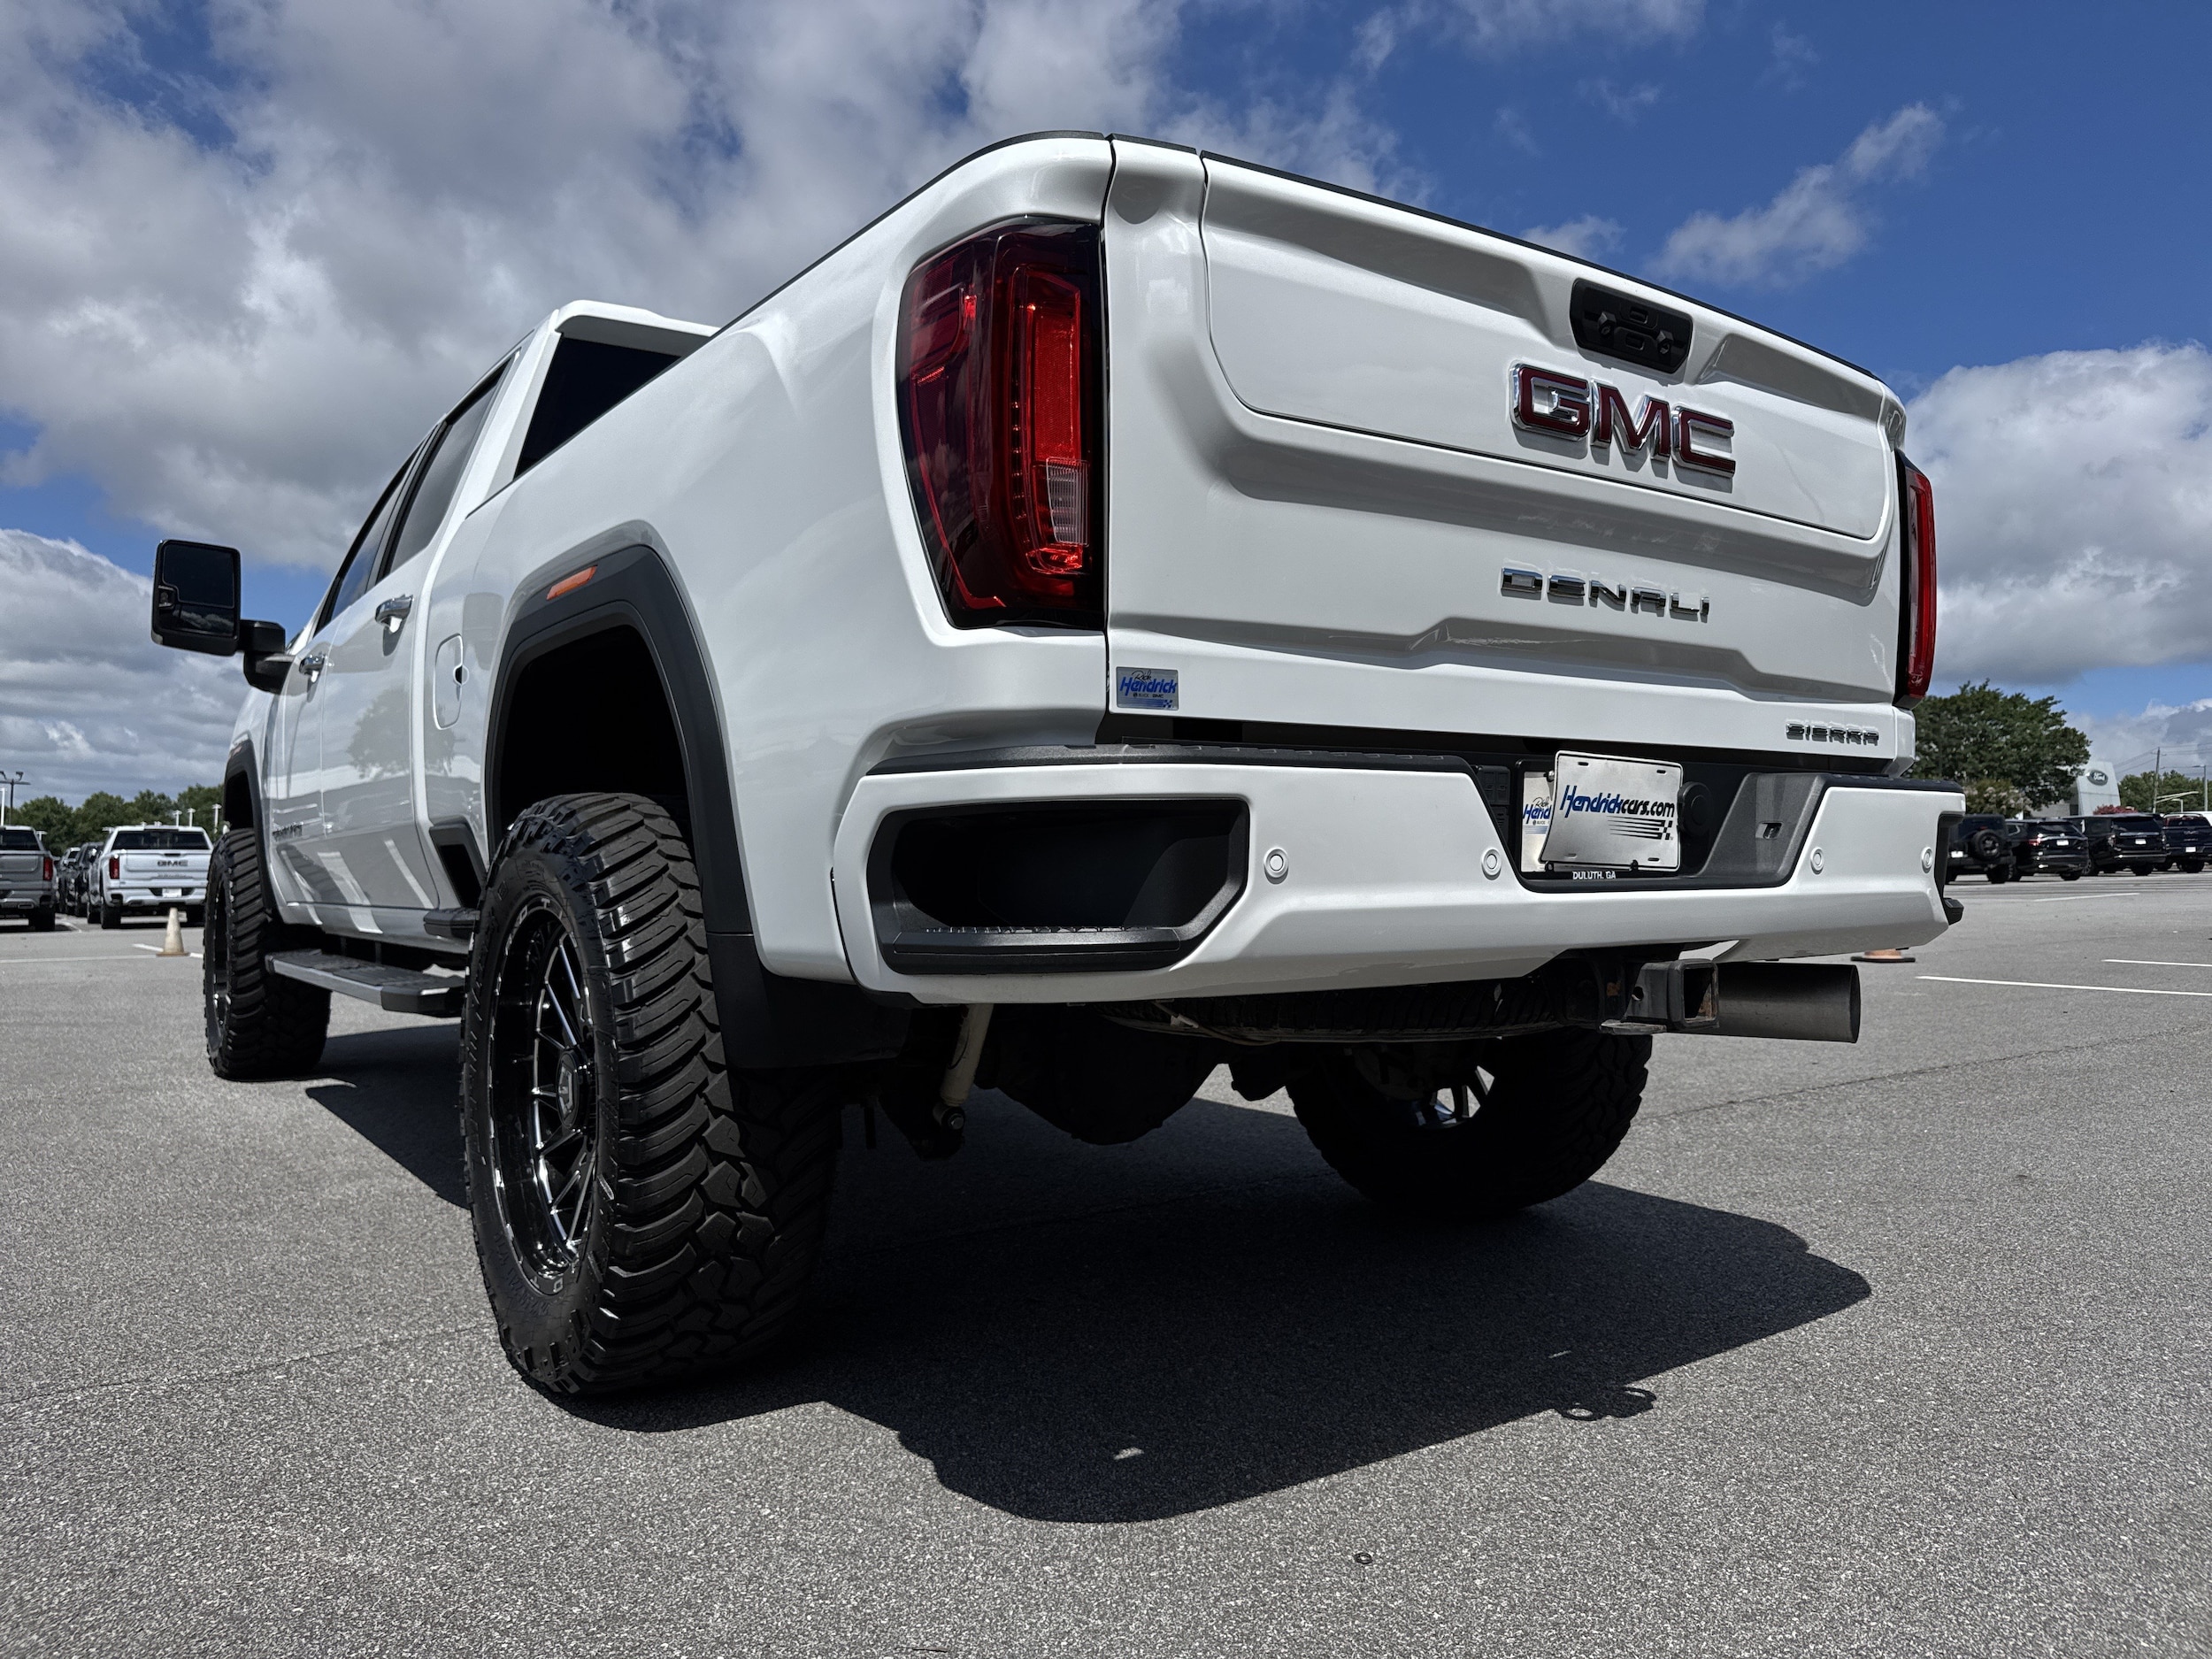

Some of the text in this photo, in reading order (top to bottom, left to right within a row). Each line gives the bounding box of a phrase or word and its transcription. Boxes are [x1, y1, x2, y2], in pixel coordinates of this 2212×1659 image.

[1509, 363, 1736, 478] GMC
[1501, 567, 1709, 616] DENALI
[1119, 676, 1178, 696] Hendrick
[1786, 723, 1879, 743] SIERRA
[1560, 785, 1675, 818] Hendrickcars.com
[1605, 871, 1616, 879] GA
